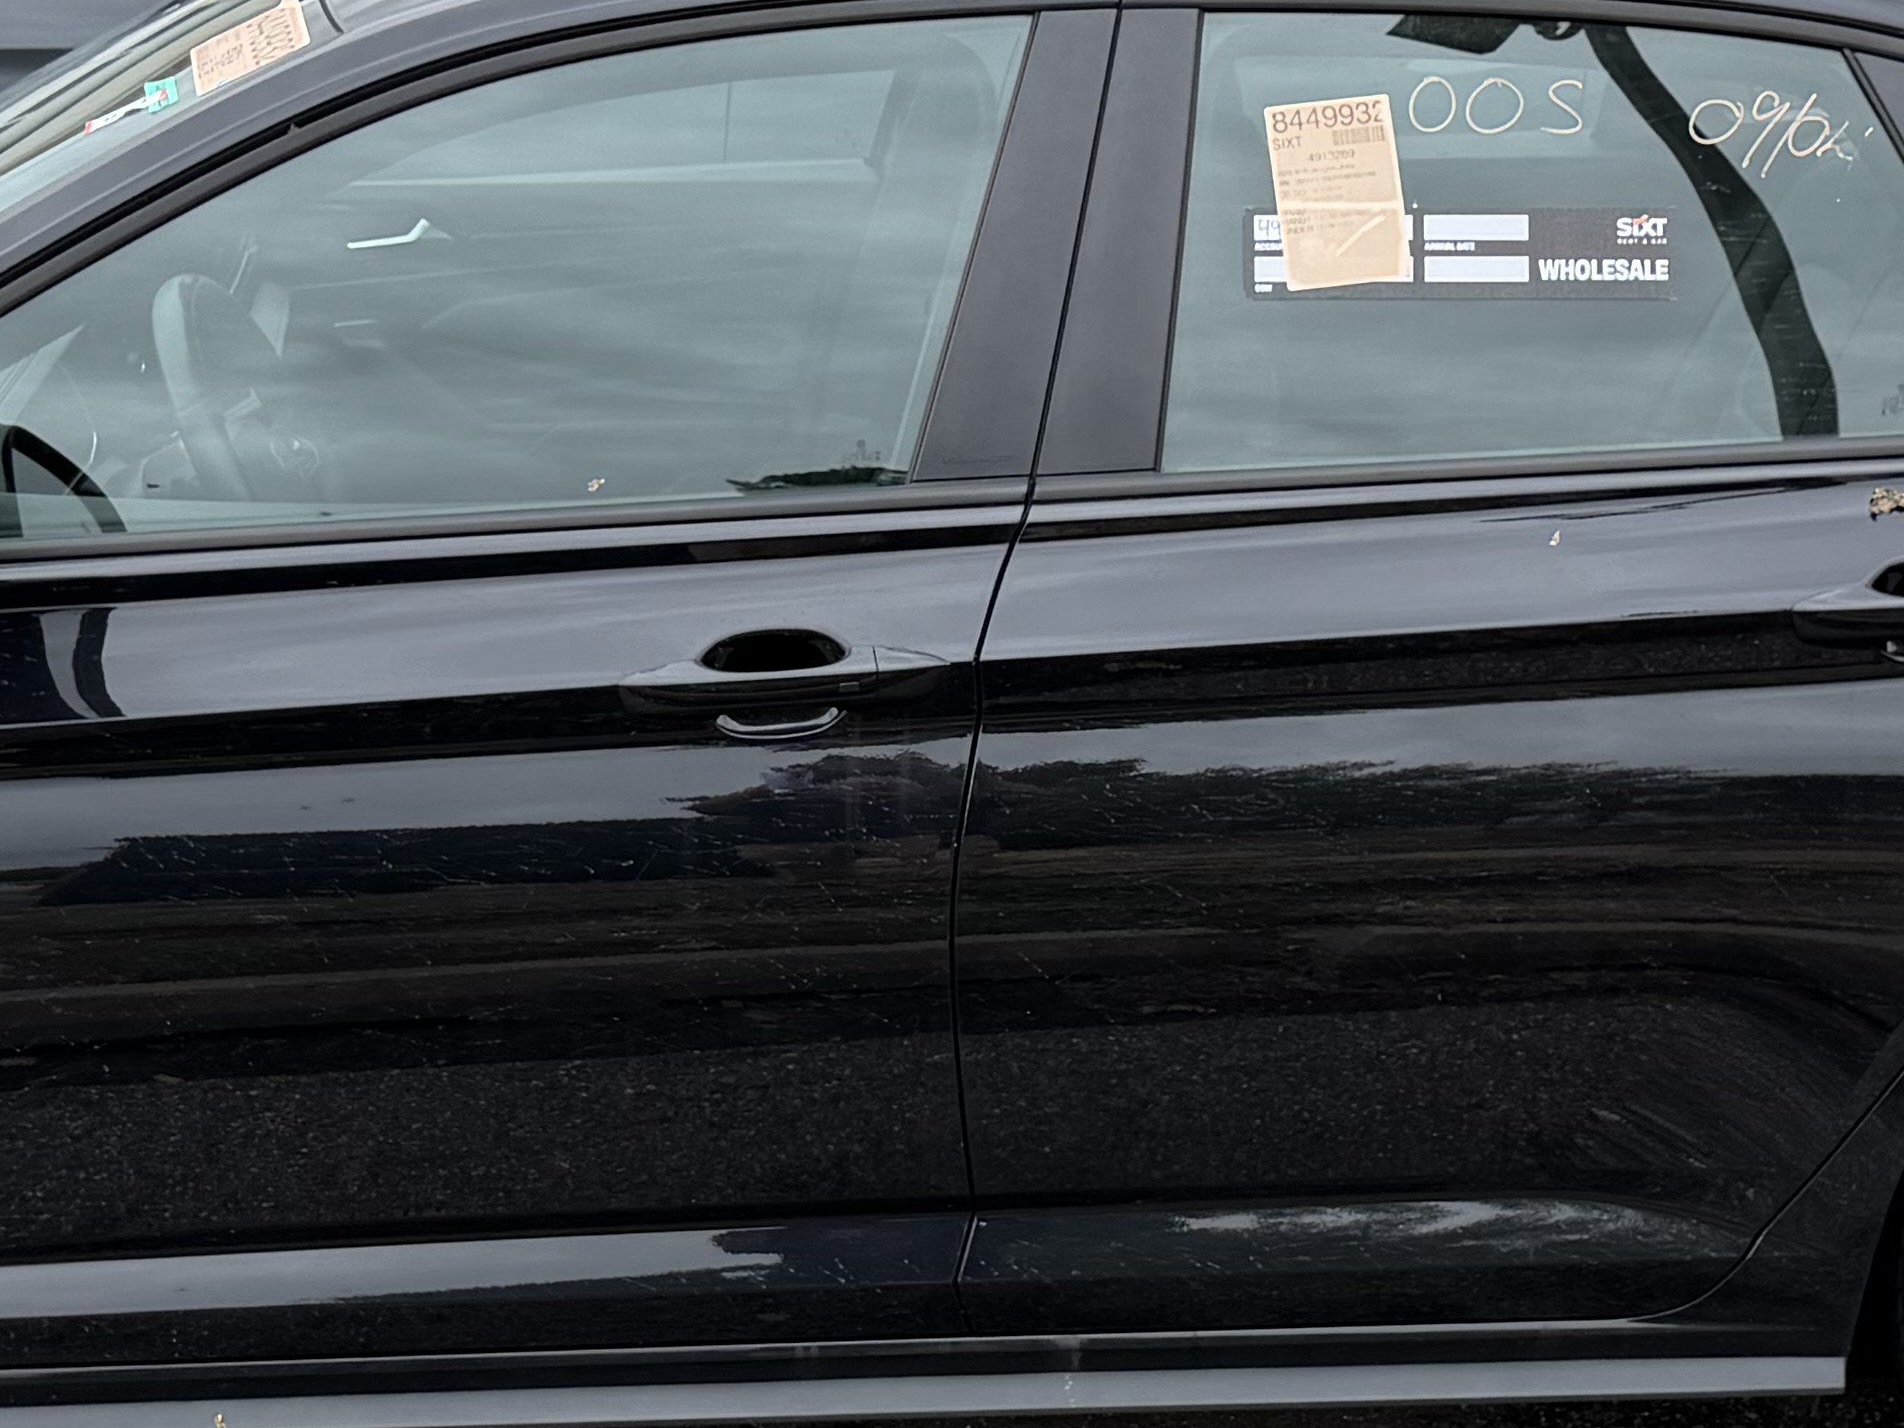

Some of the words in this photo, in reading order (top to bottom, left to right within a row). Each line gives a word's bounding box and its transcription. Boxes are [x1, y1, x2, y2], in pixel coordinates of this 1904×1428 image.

[1272, 135, 1302, 151] SIXT
[1616, 214, 1668, 237] SIXT
[1538, 259, 1670, 281] WHOLESALE
